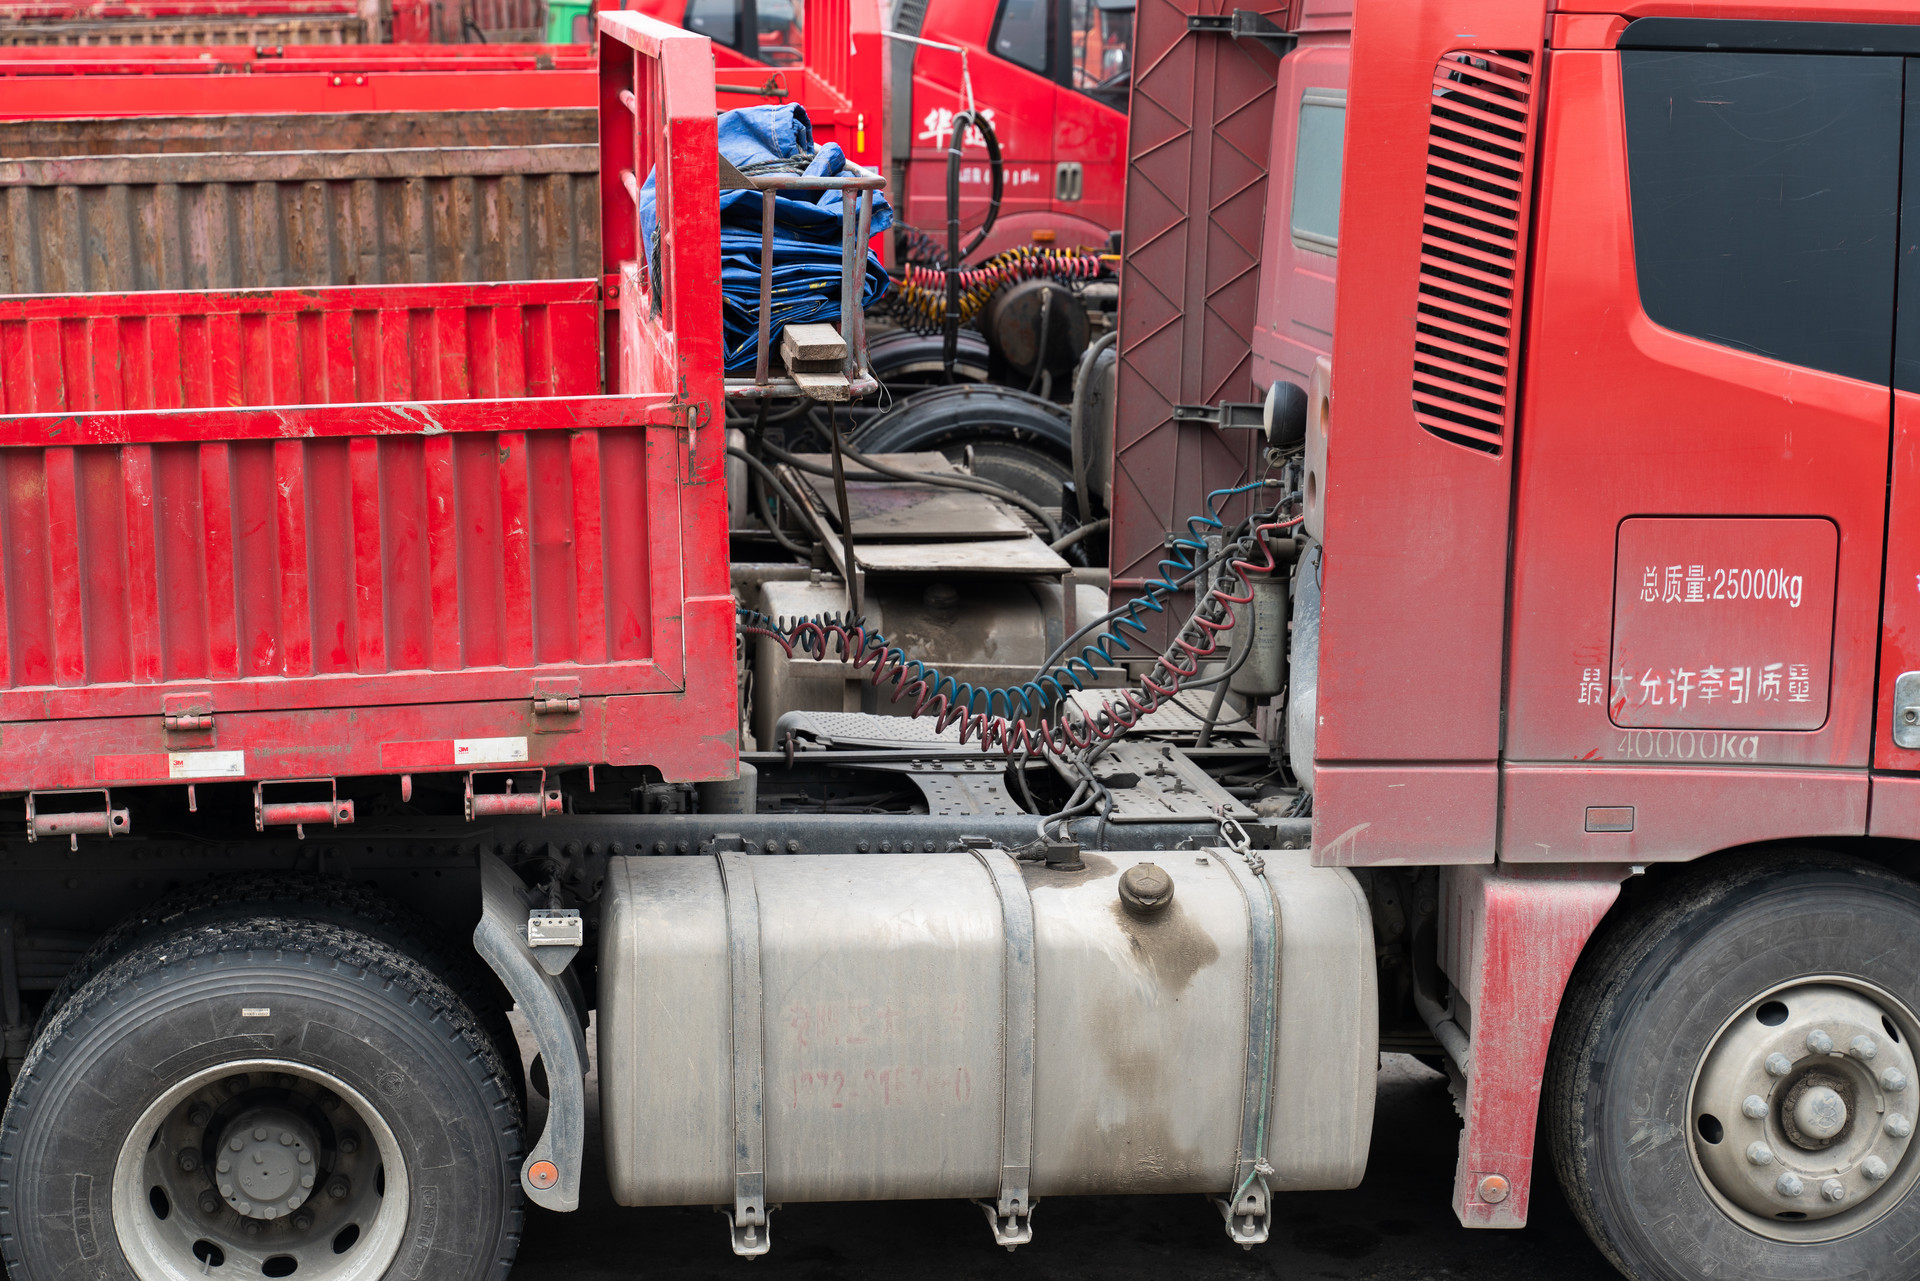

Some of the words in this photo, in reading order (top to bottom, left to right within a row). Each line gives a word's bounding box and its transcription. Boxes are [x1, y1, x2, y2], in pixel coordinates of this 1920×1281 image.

[1640, 564, 1803, 608] 总质量:25000kg
[1578, 662, 1812, 709] 最大允许牵引质量
